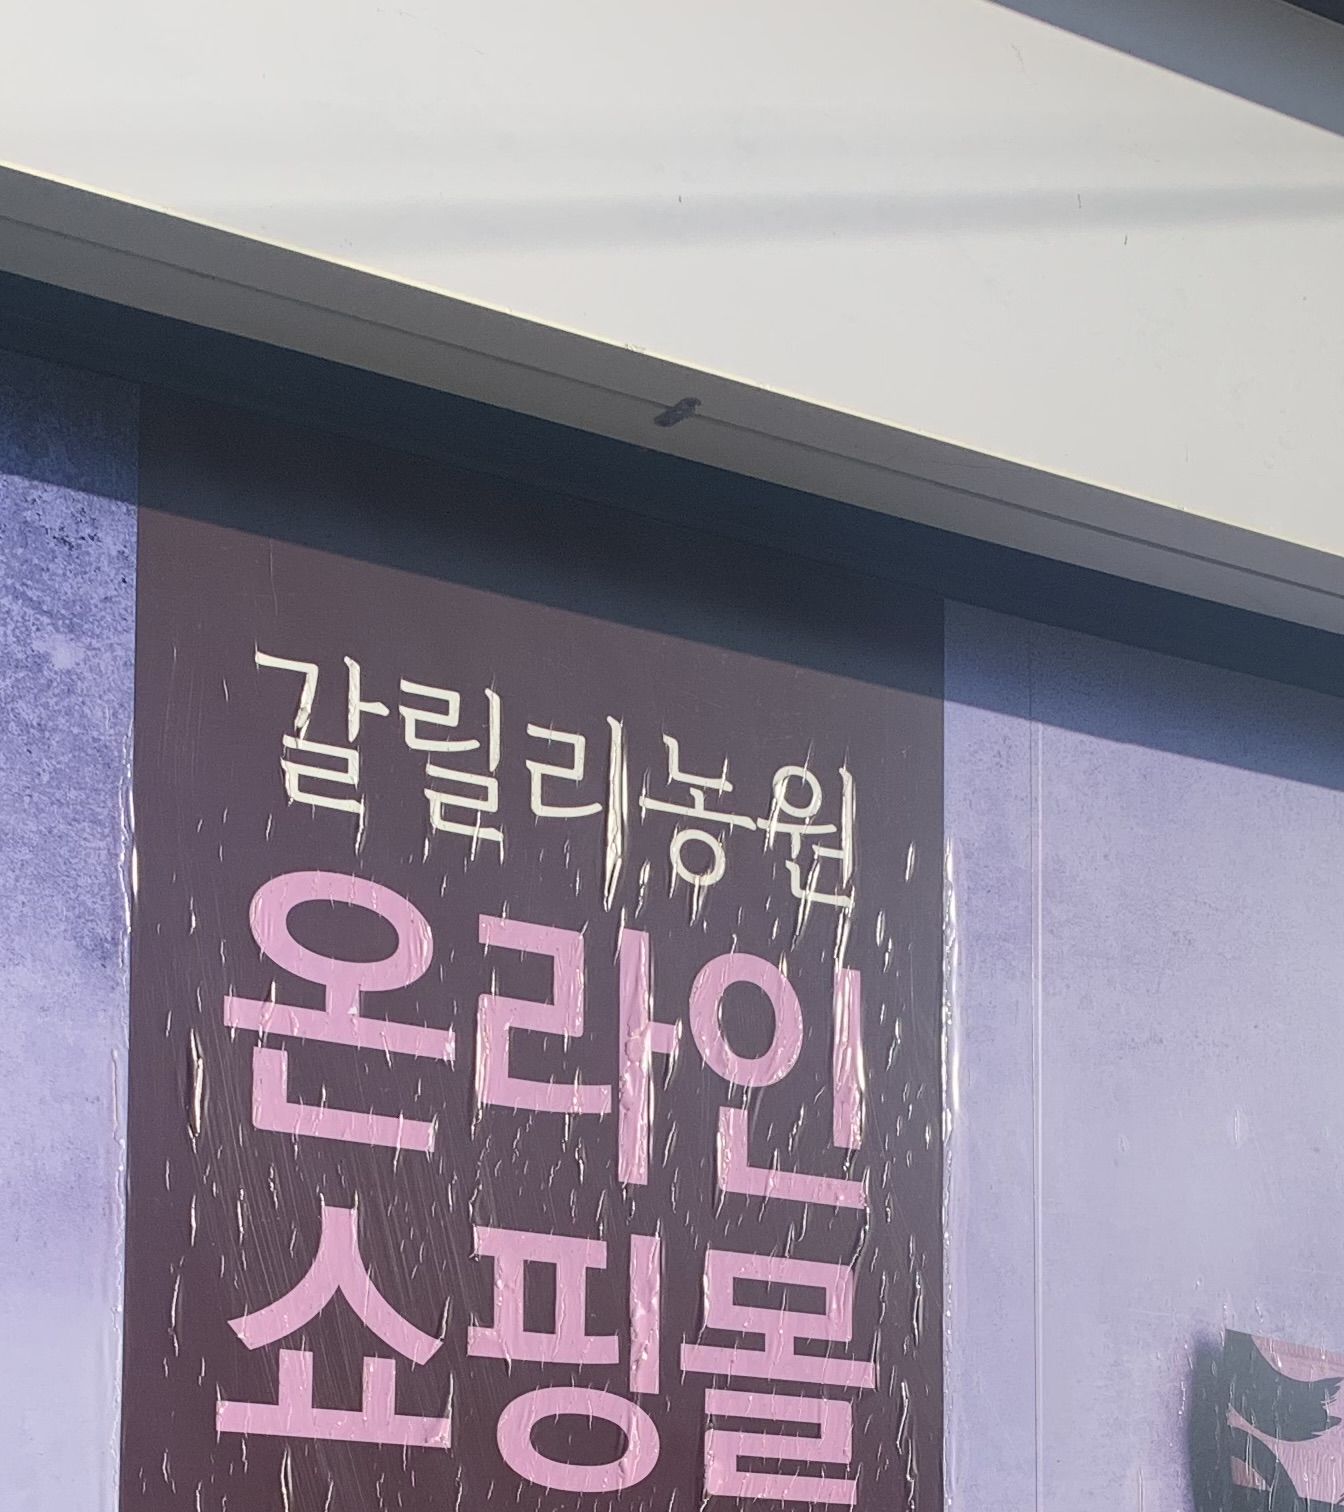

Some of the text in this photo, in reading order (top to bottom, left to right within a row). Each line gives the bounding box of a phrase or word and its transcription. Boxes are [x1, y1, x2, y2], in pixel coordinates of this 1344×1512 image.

[256, 650, 855, 908] 갈릴리농원
[223, 870, 865, 1210] 온라인
[215, 1206, 877, 1506] 쇼핑몰
